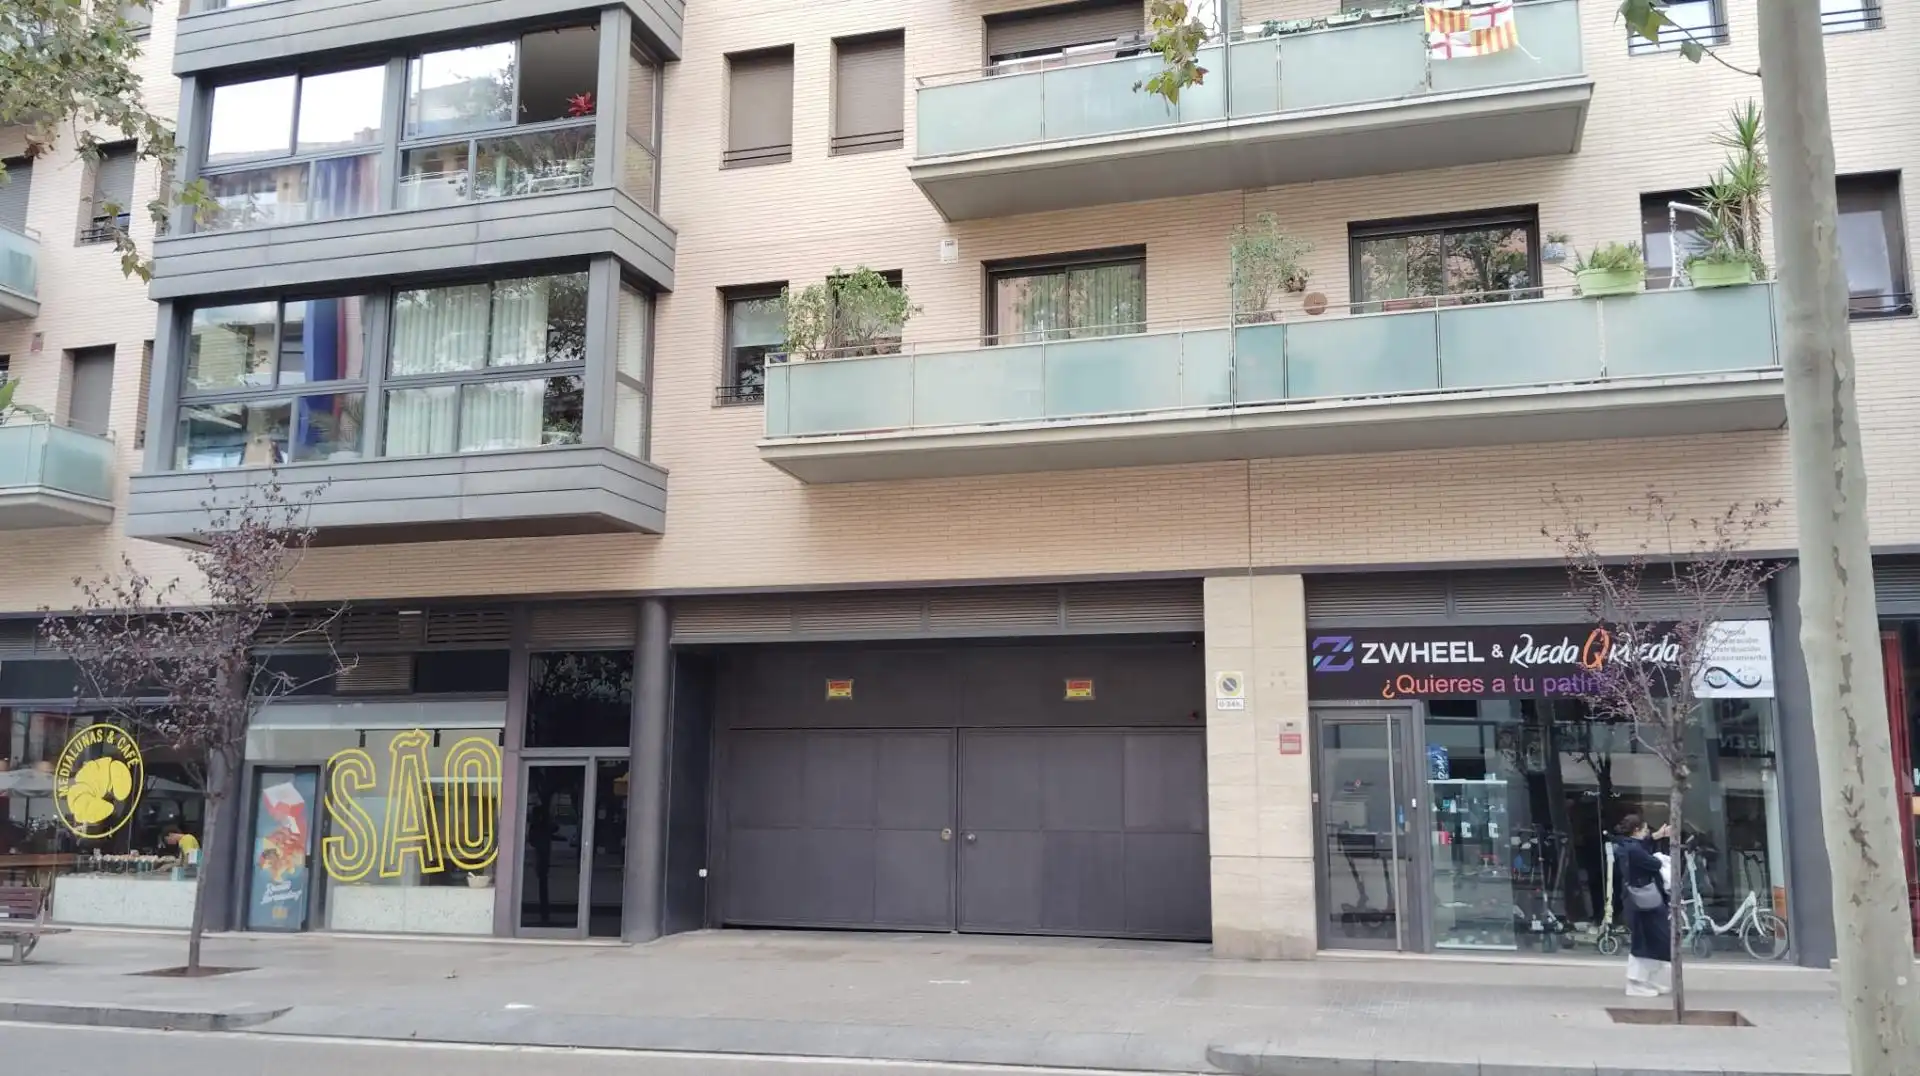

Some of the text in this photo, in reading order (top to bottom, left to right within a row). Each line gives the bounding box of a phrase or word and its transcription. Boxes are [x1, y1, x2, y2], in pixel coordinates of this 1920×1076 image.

[1361, 641, 1485, 664] ZWHEEL
[1491, 643, 1503, 658] &
[1382, 674, 1484, 699] ¿Quieres
[1492, 677, 1506, 693] a
[1512, 673, 1534, 693] tu
[58, 729, 103, 797] MEDIALUNAS
[106, 730, 115, 744] &
